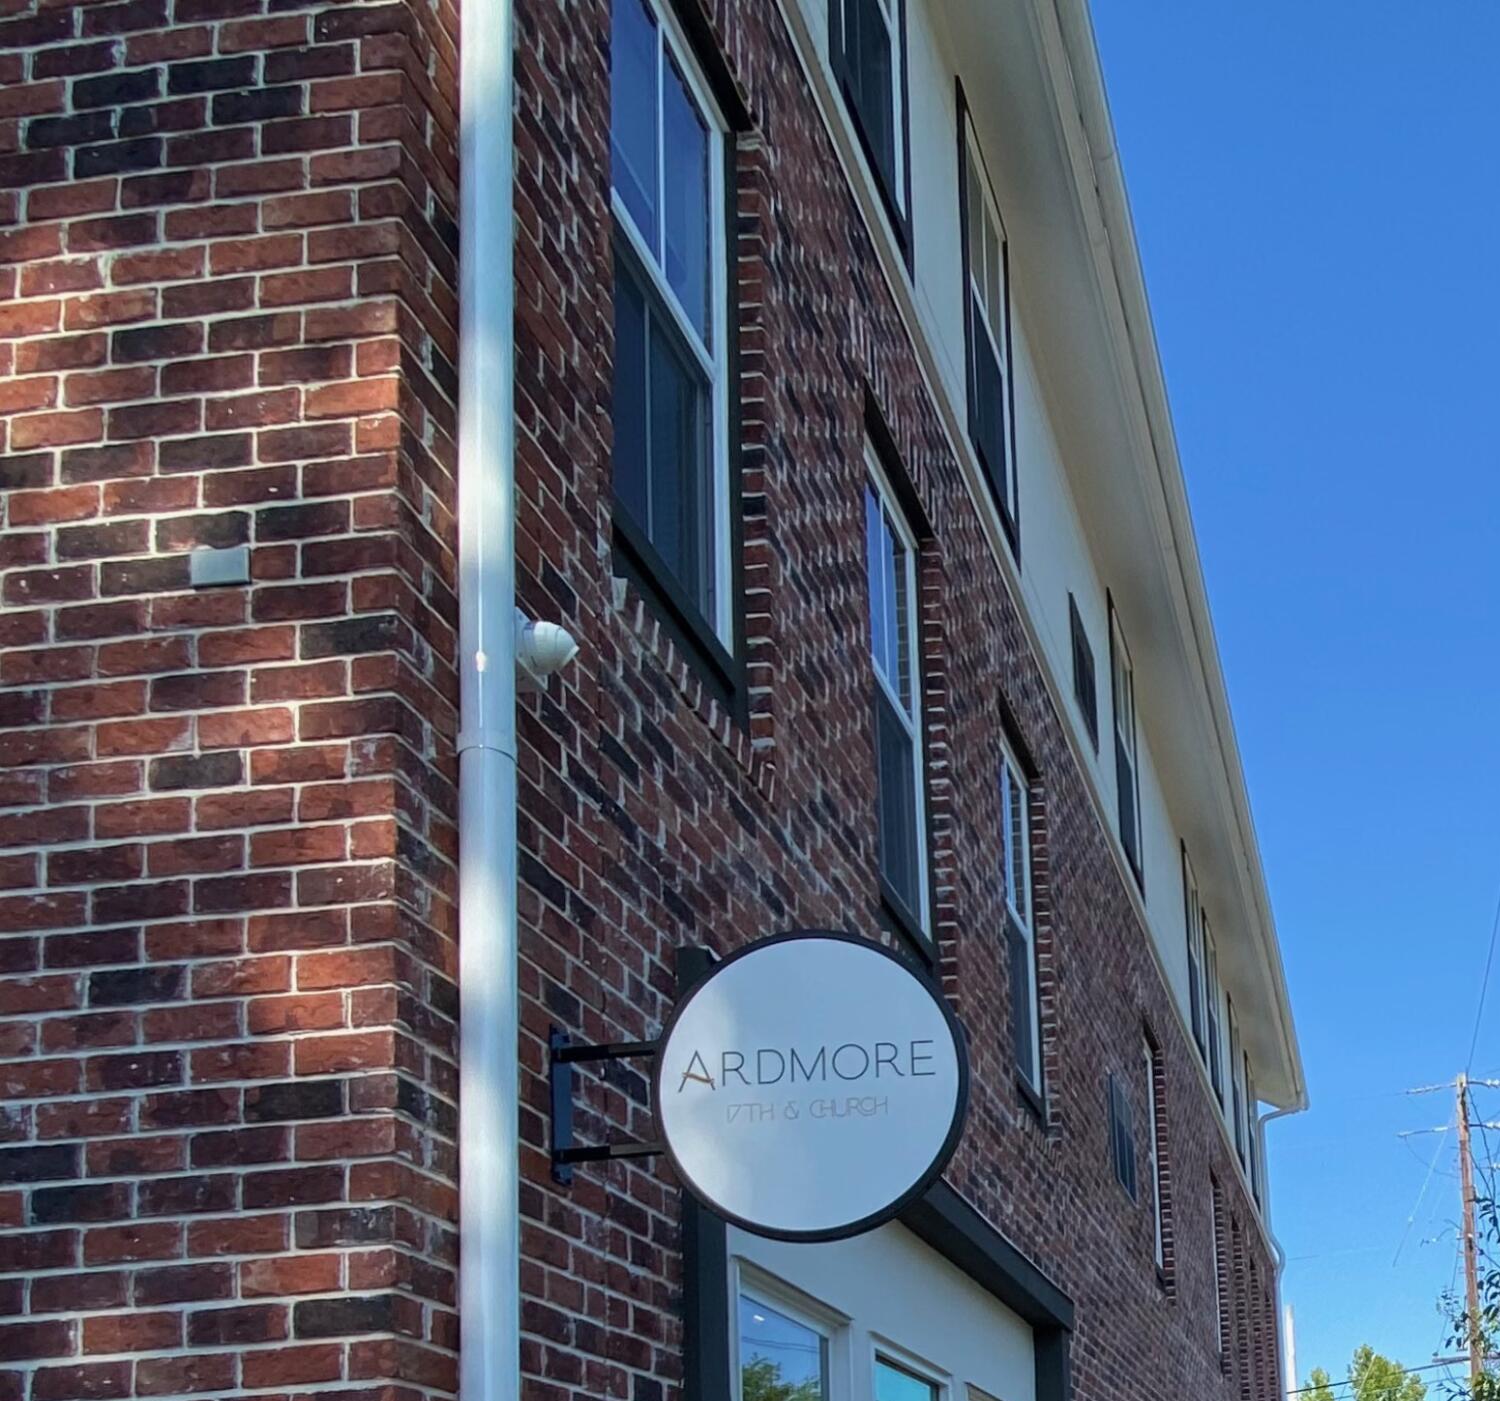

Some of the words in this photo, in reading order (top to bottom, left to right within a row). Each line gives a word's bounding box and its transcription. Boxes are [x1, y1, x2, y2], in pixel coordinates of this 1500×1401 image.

[678, 1040, 936, 1093] ARDMORE
[783, 1100, 800, 1121] &
[808, 1096, 889, 1119] CHURCH
